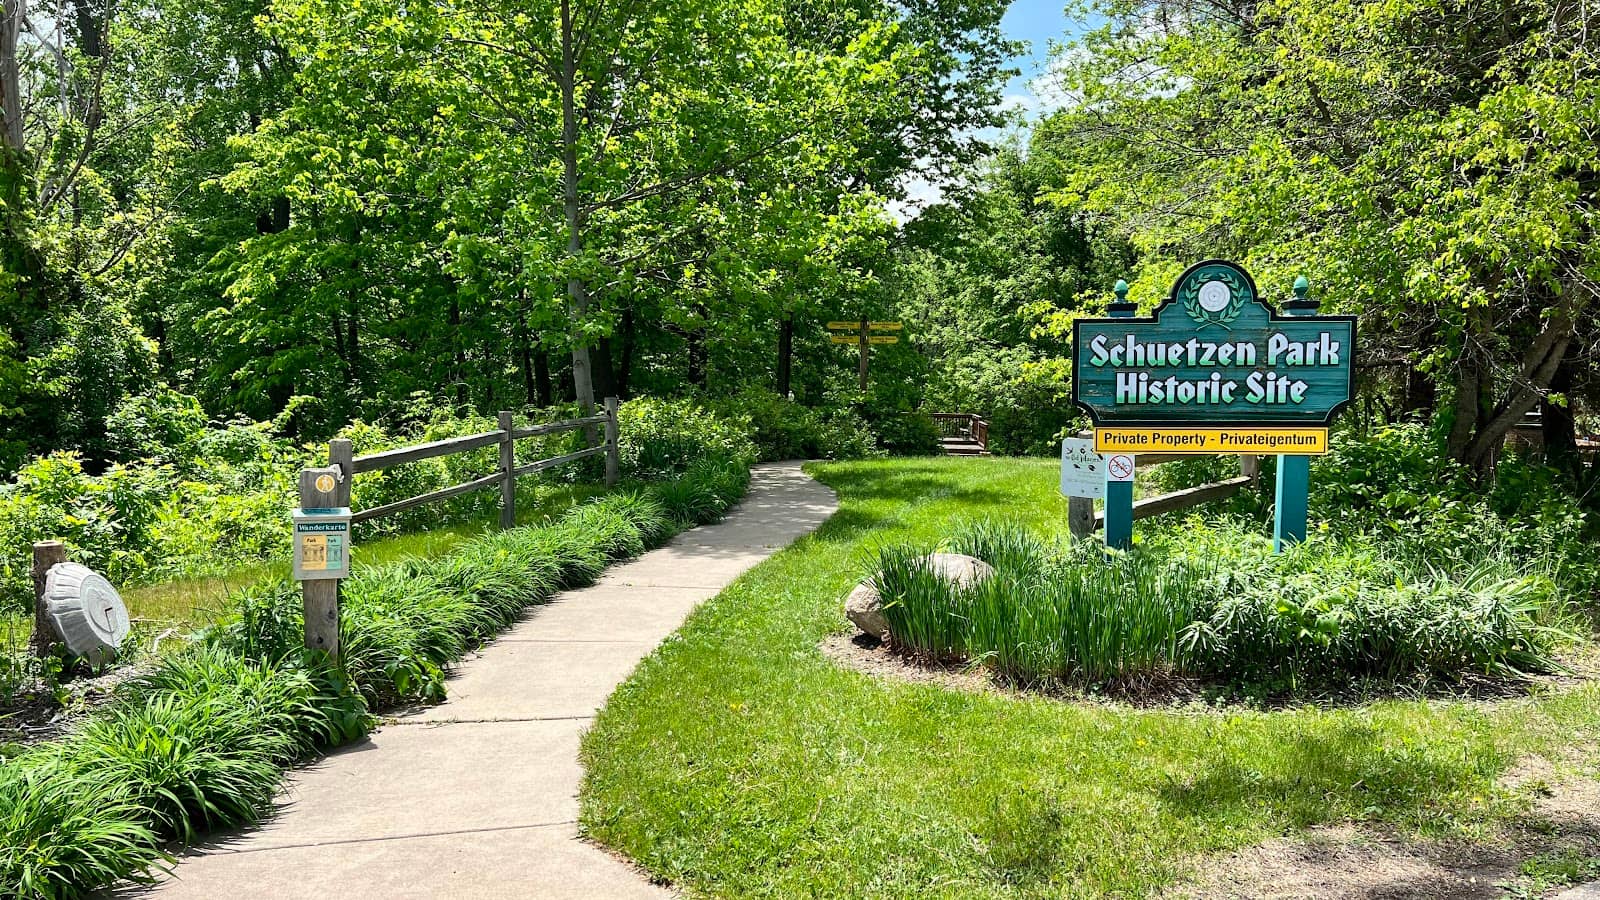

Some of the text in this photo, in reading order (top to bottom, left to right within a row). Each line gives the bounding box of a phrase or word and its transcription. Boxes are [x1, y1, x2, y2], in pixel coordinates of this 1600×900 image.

[1090, 332, 1340, 367] Schuetzen Park
[1115, 371, 1308, 404] Historic Site
[1104, 433, 1148, 445] Private
[1152, 433, 1206, 447] Property
[1220, 433, 1317, 447] Privateigentum
